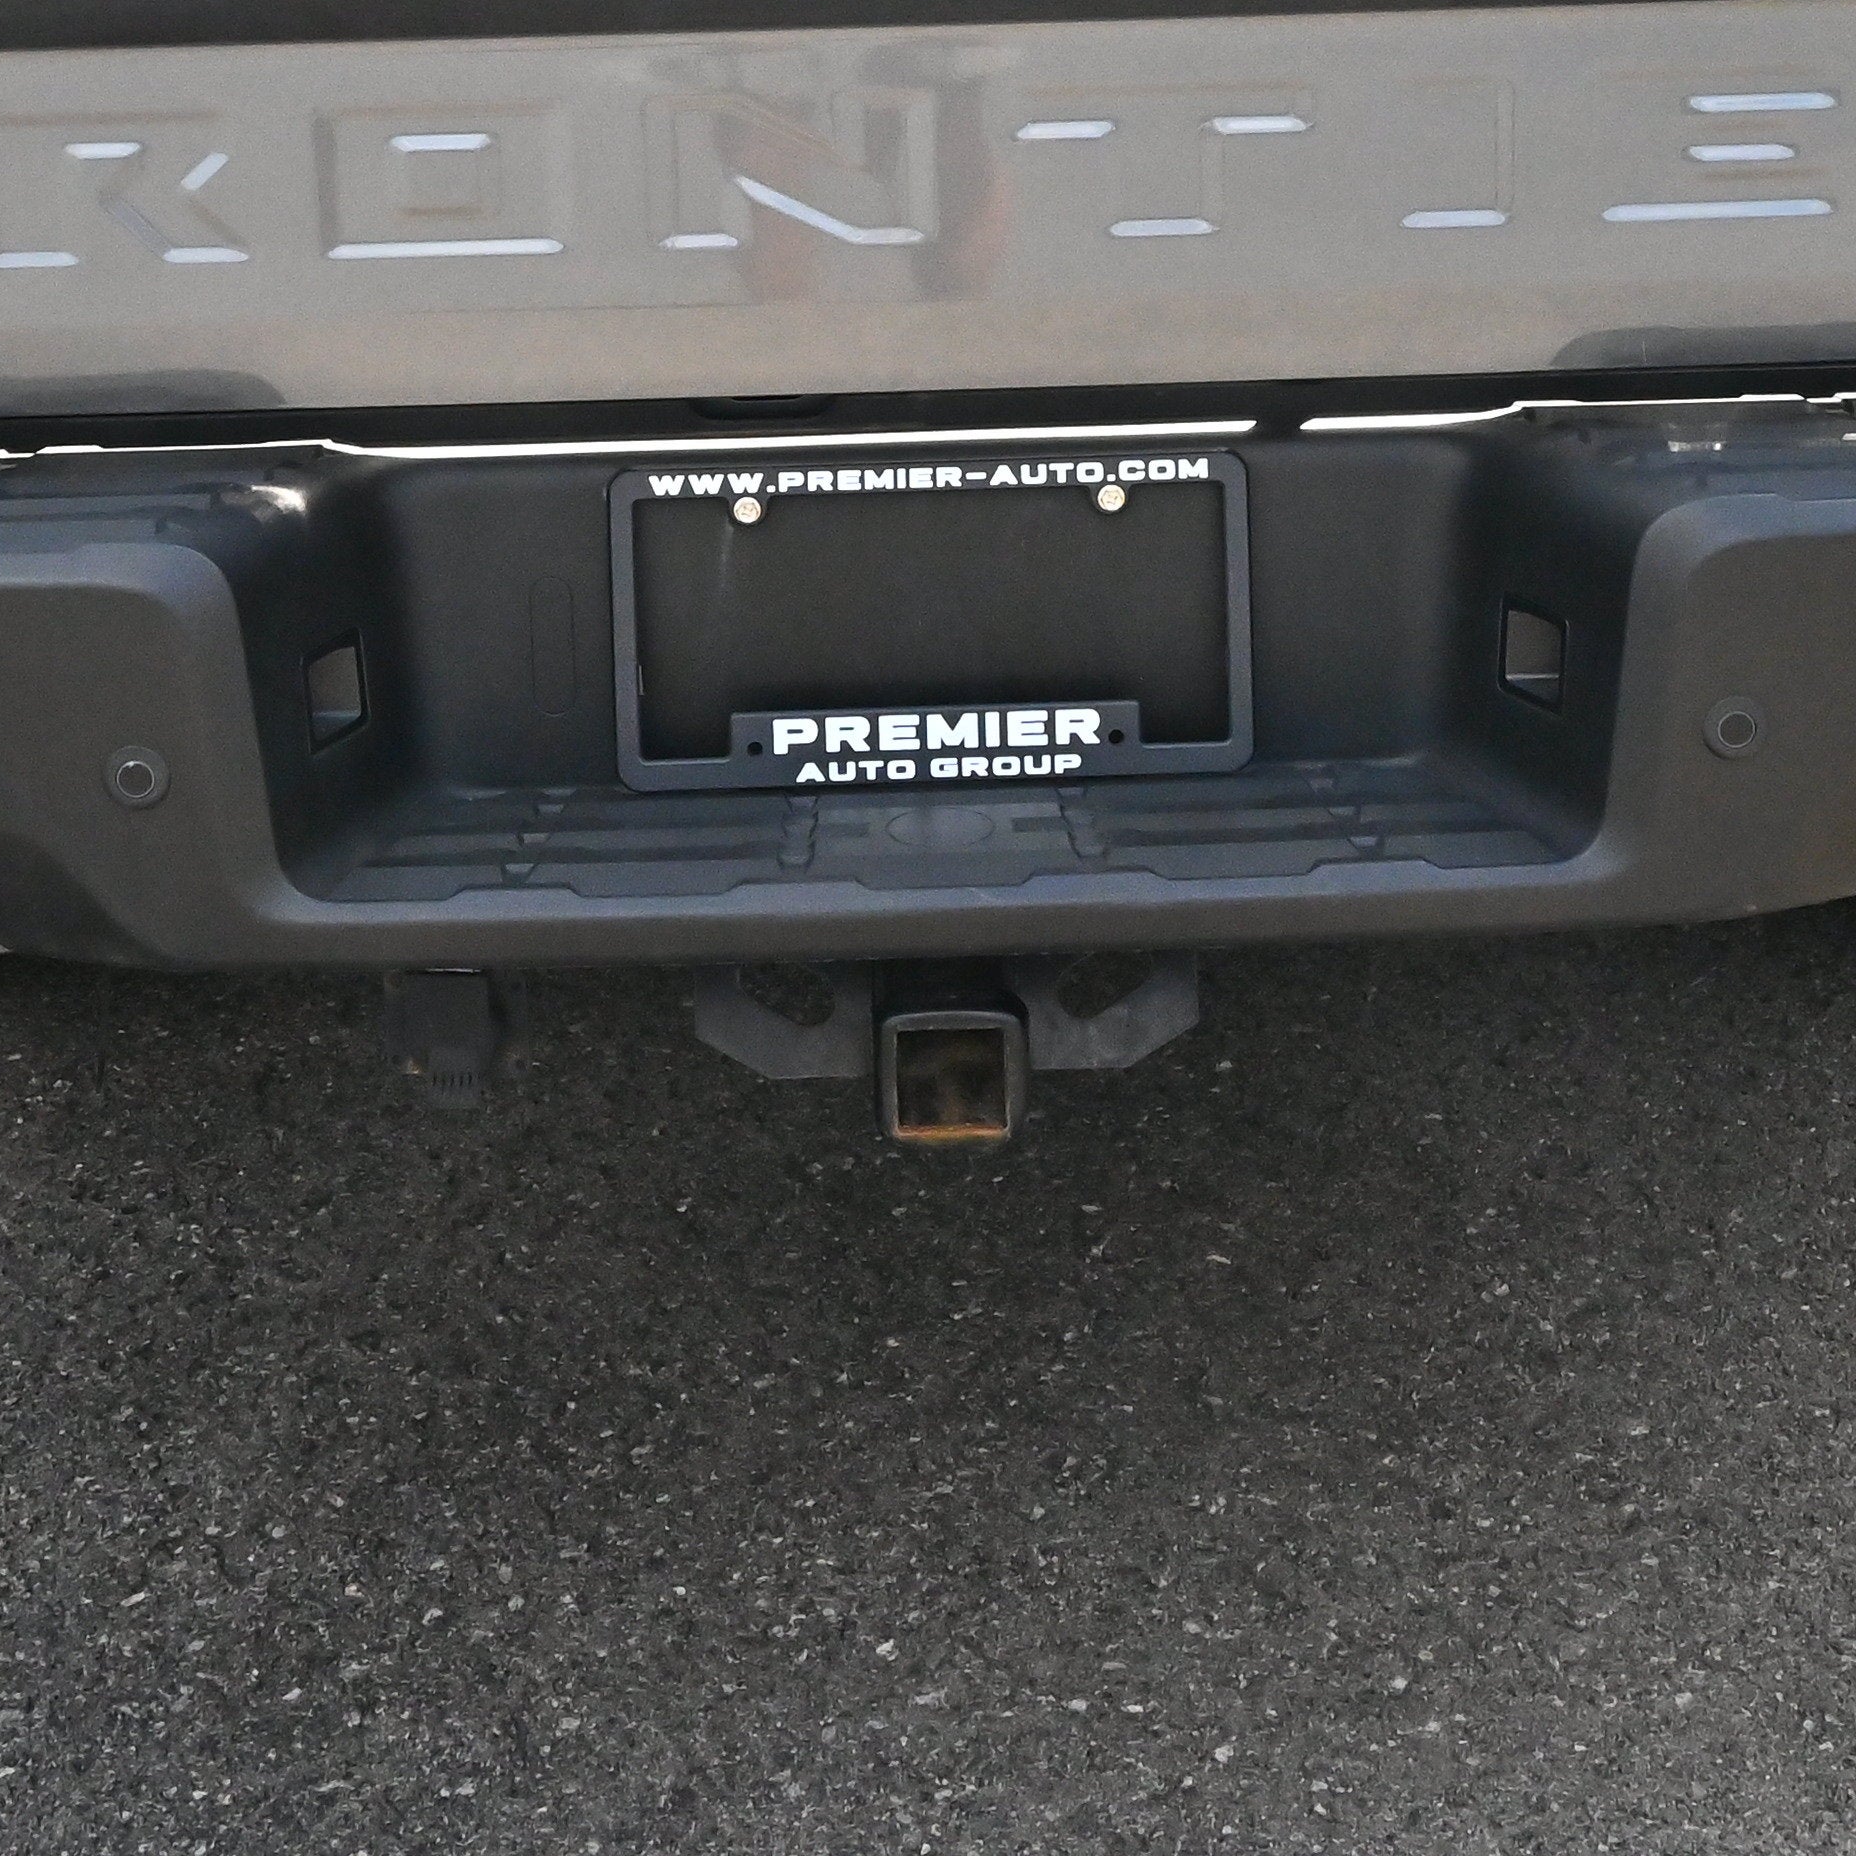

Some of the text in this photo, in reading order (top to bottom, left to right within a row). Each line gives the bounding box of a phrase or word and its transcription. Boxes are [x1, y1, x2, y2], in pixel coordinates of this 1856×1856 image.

[648, 458, 1210, 497] WWW.PREMIER-AUTO.COM
[771, 708, 1102, 755] PREMIER
[795, 753, 1082, 784] AUTO GROUP
